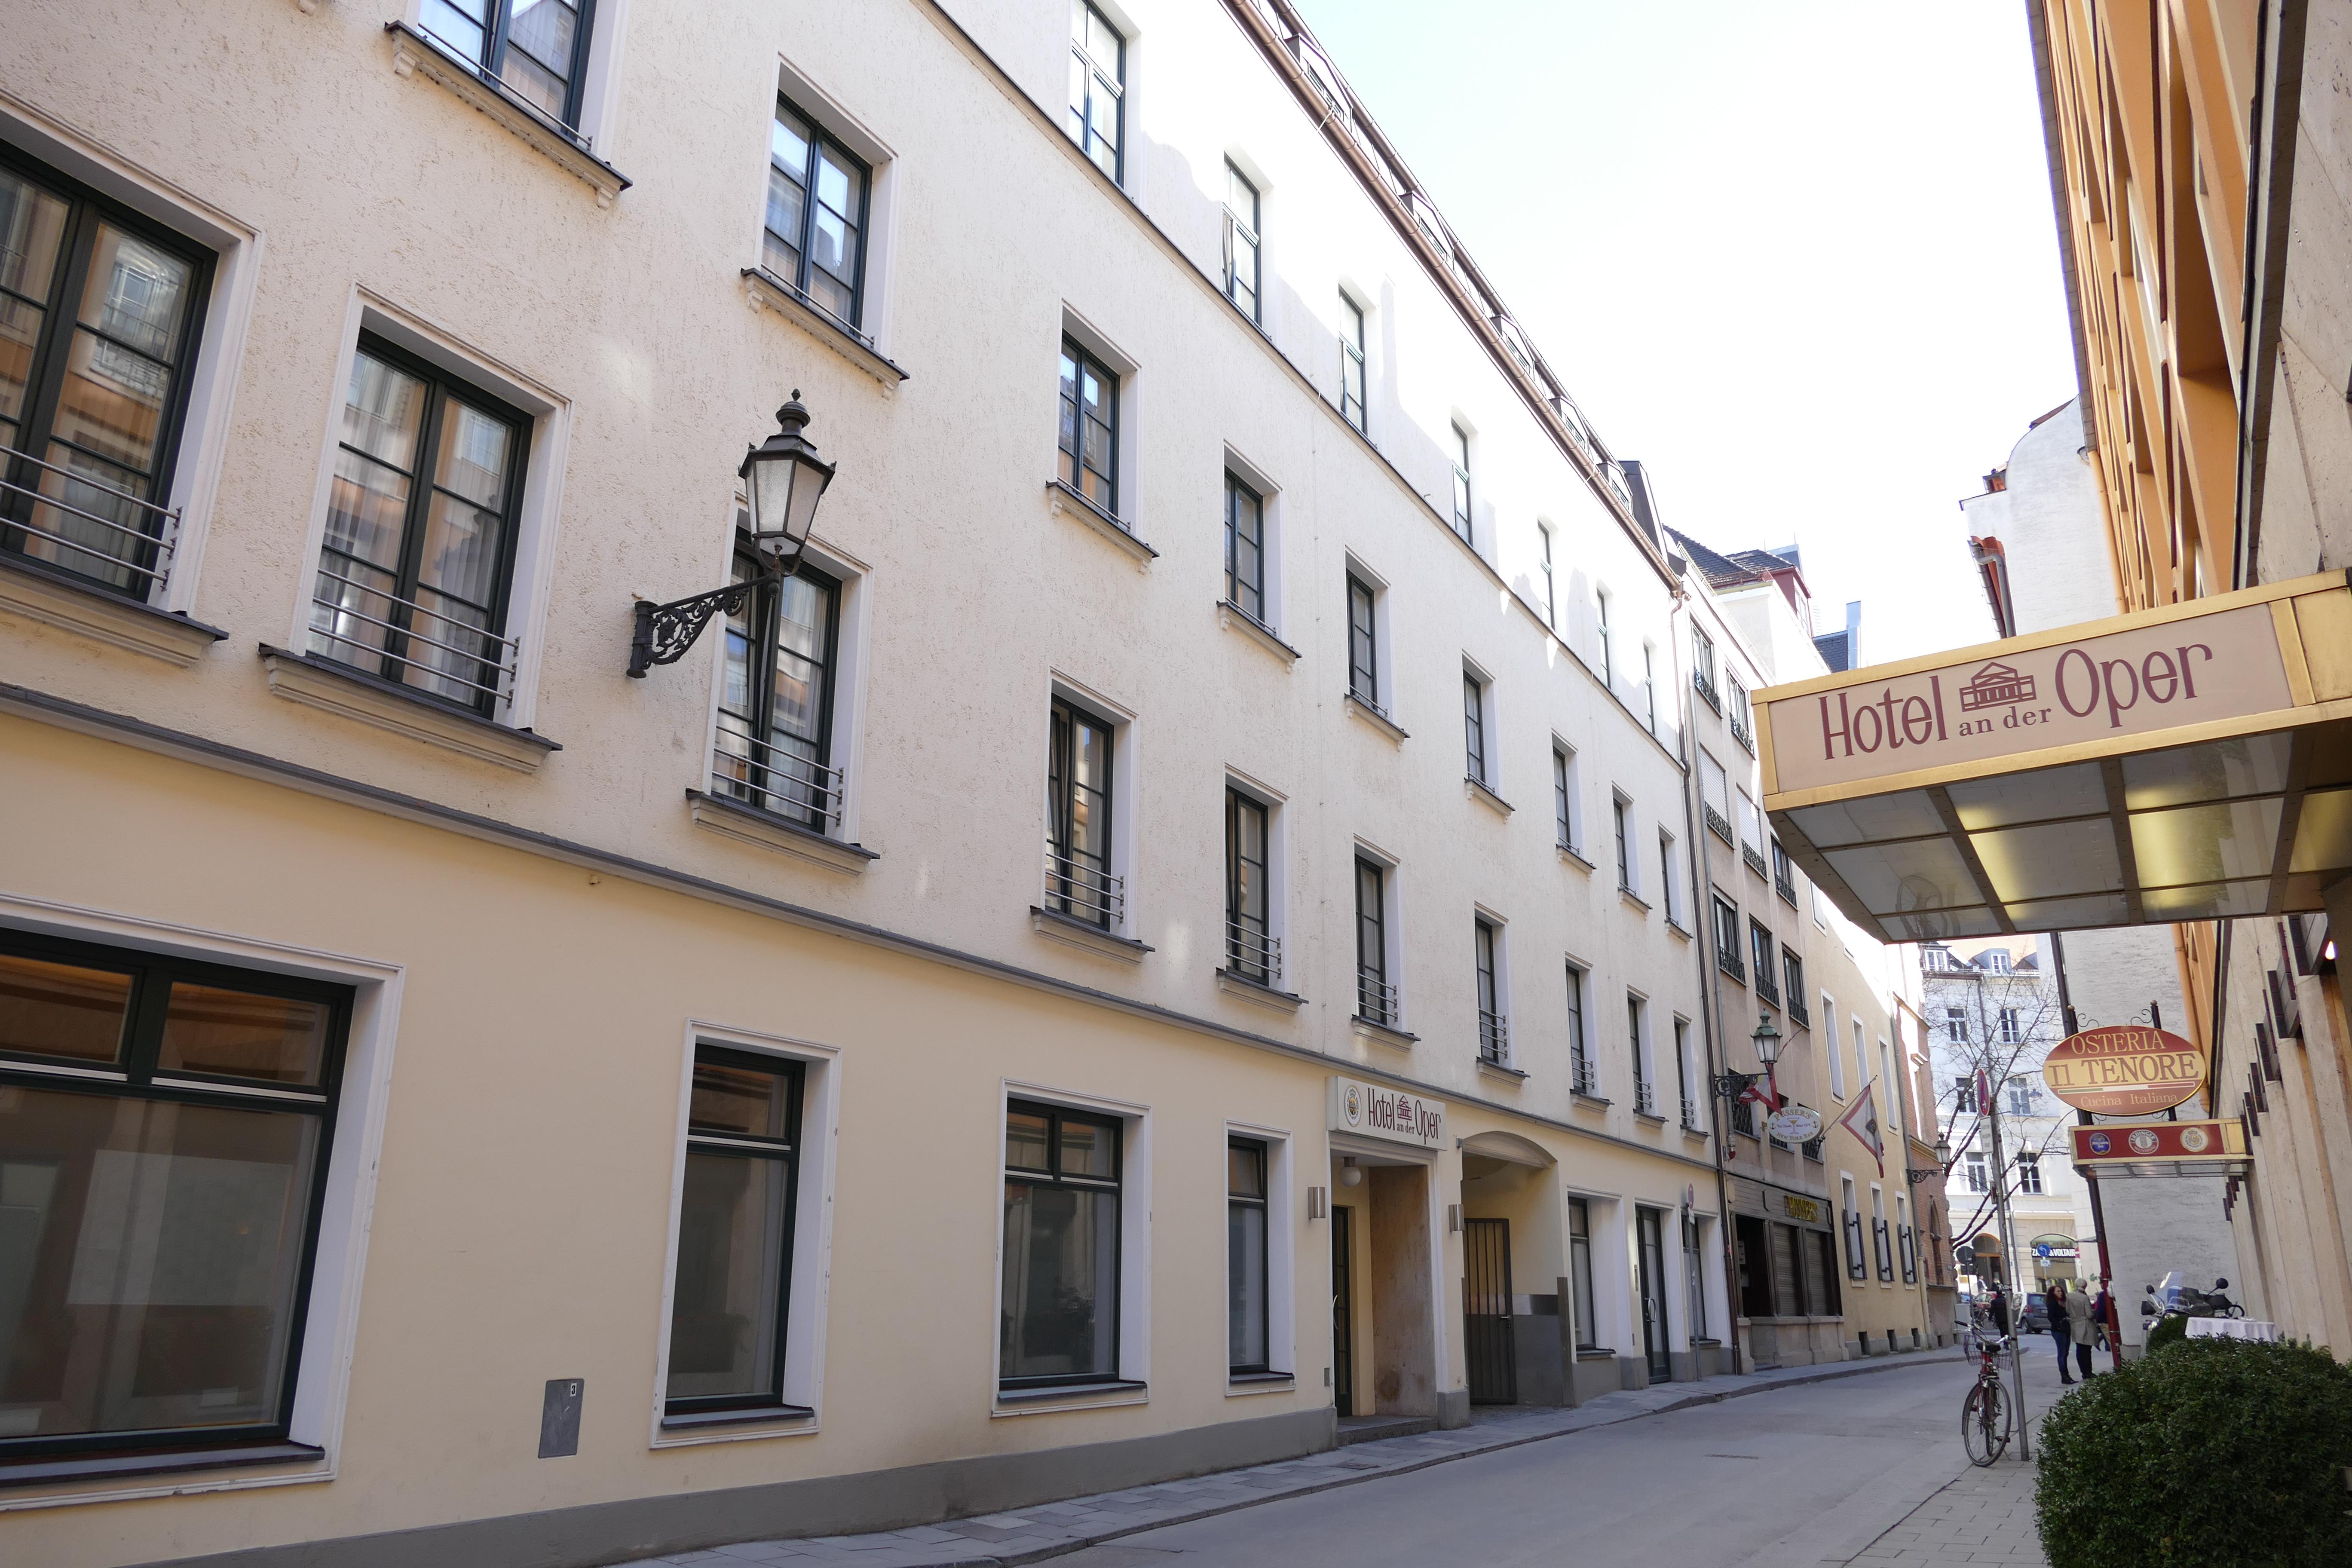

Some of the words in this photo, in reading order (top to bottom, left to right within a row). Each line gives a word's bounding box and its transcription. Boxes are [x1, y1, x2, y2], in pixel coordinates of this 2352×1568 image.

[1818, 675, 1949, 760] Hotel
[1959, 717, 1994, 737] an
[2003, 705, 2052, 729] der
[2055, 644, 2213, 729] Oper
[2071, 1030, 2166, 1055] OSTERIA
[2081, 1053, 2199, 1084] TENORE
[2080, 1095, 2122, 1108] Cucina
[2129, 1092, 2178, 1105] Italiana
[1367, 1087, 1395, 1130] Hotel
[1397, 1124, 1404, 1132] an
[1405, 1121, 1415, 1134] der
[1415, 1099, 1441, 1145] Oper
[571, 1385, 576, 1395] 3
